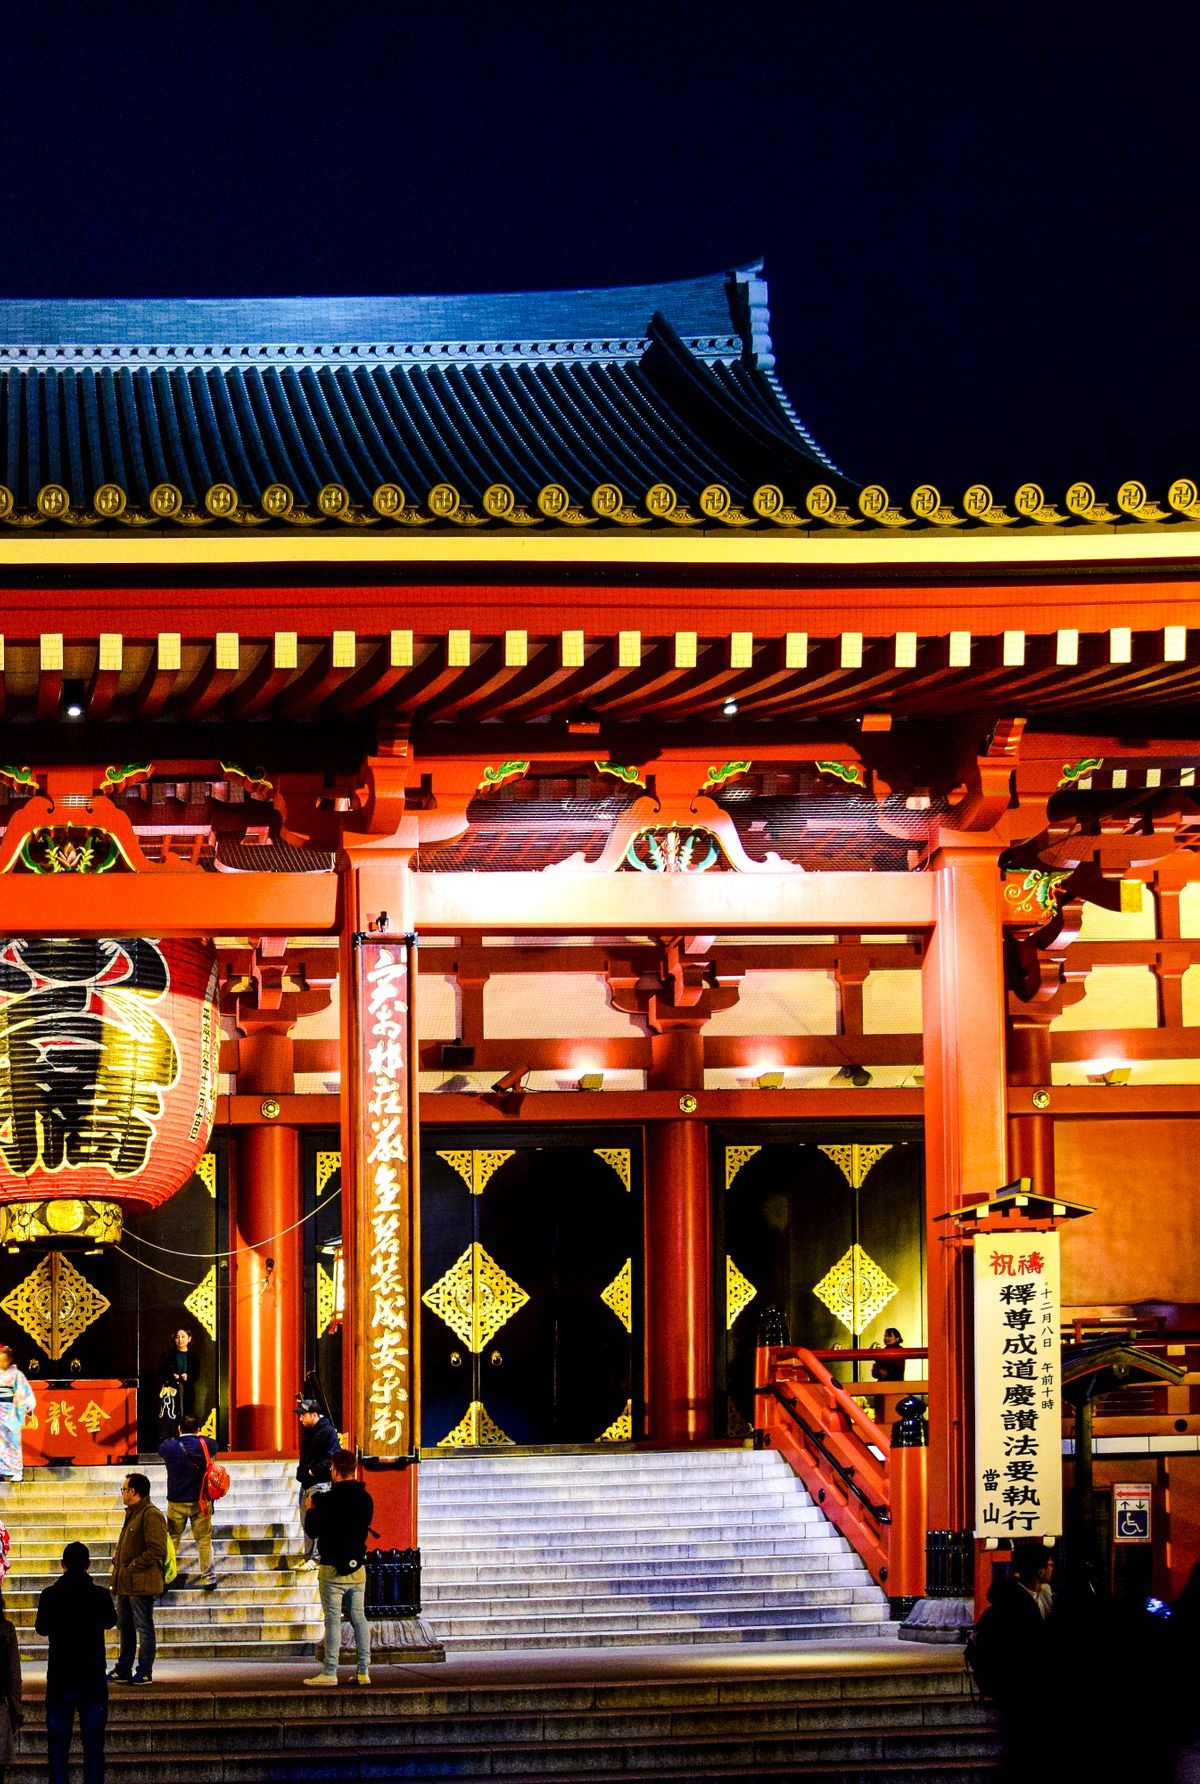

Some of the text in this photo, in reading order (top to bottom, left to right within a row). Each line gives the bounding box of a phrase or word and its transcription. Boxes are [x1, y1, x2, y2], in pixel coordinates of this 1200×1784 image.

[1040, 1288, 1054, 1410] 十二月八日 午前十時
